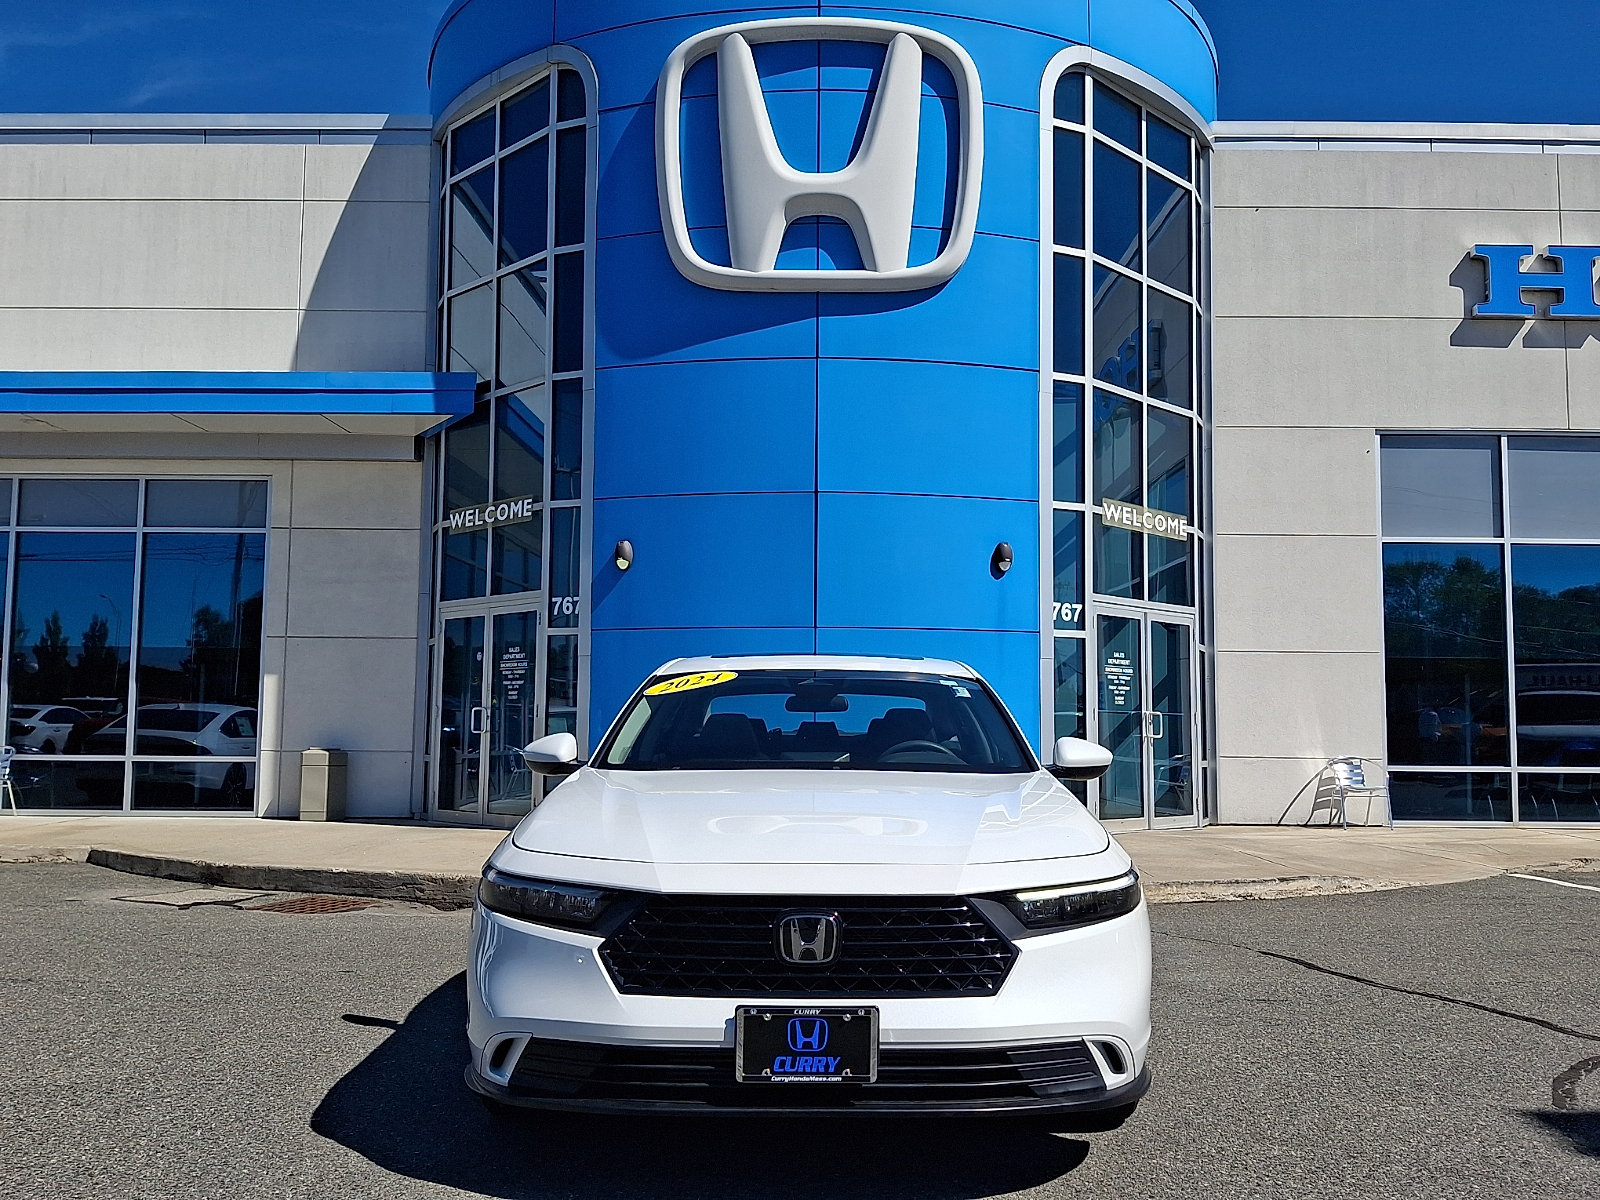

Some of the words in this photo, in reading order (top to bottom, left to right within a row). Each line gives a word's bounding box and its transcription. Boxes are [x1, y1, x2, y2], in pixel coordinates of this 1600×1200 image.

[450, 498, 533, 530] WELCOME
[1103, 502, 1188, 537] WELCOME
[551, 596, 580, 616] 767
[1052, 602, 1083, 623] 767
[659, 672, 723, 693] 2024
[793, 1008, 822, 1016] CURRY
[773, 1056, 841, 1073] CURRY
